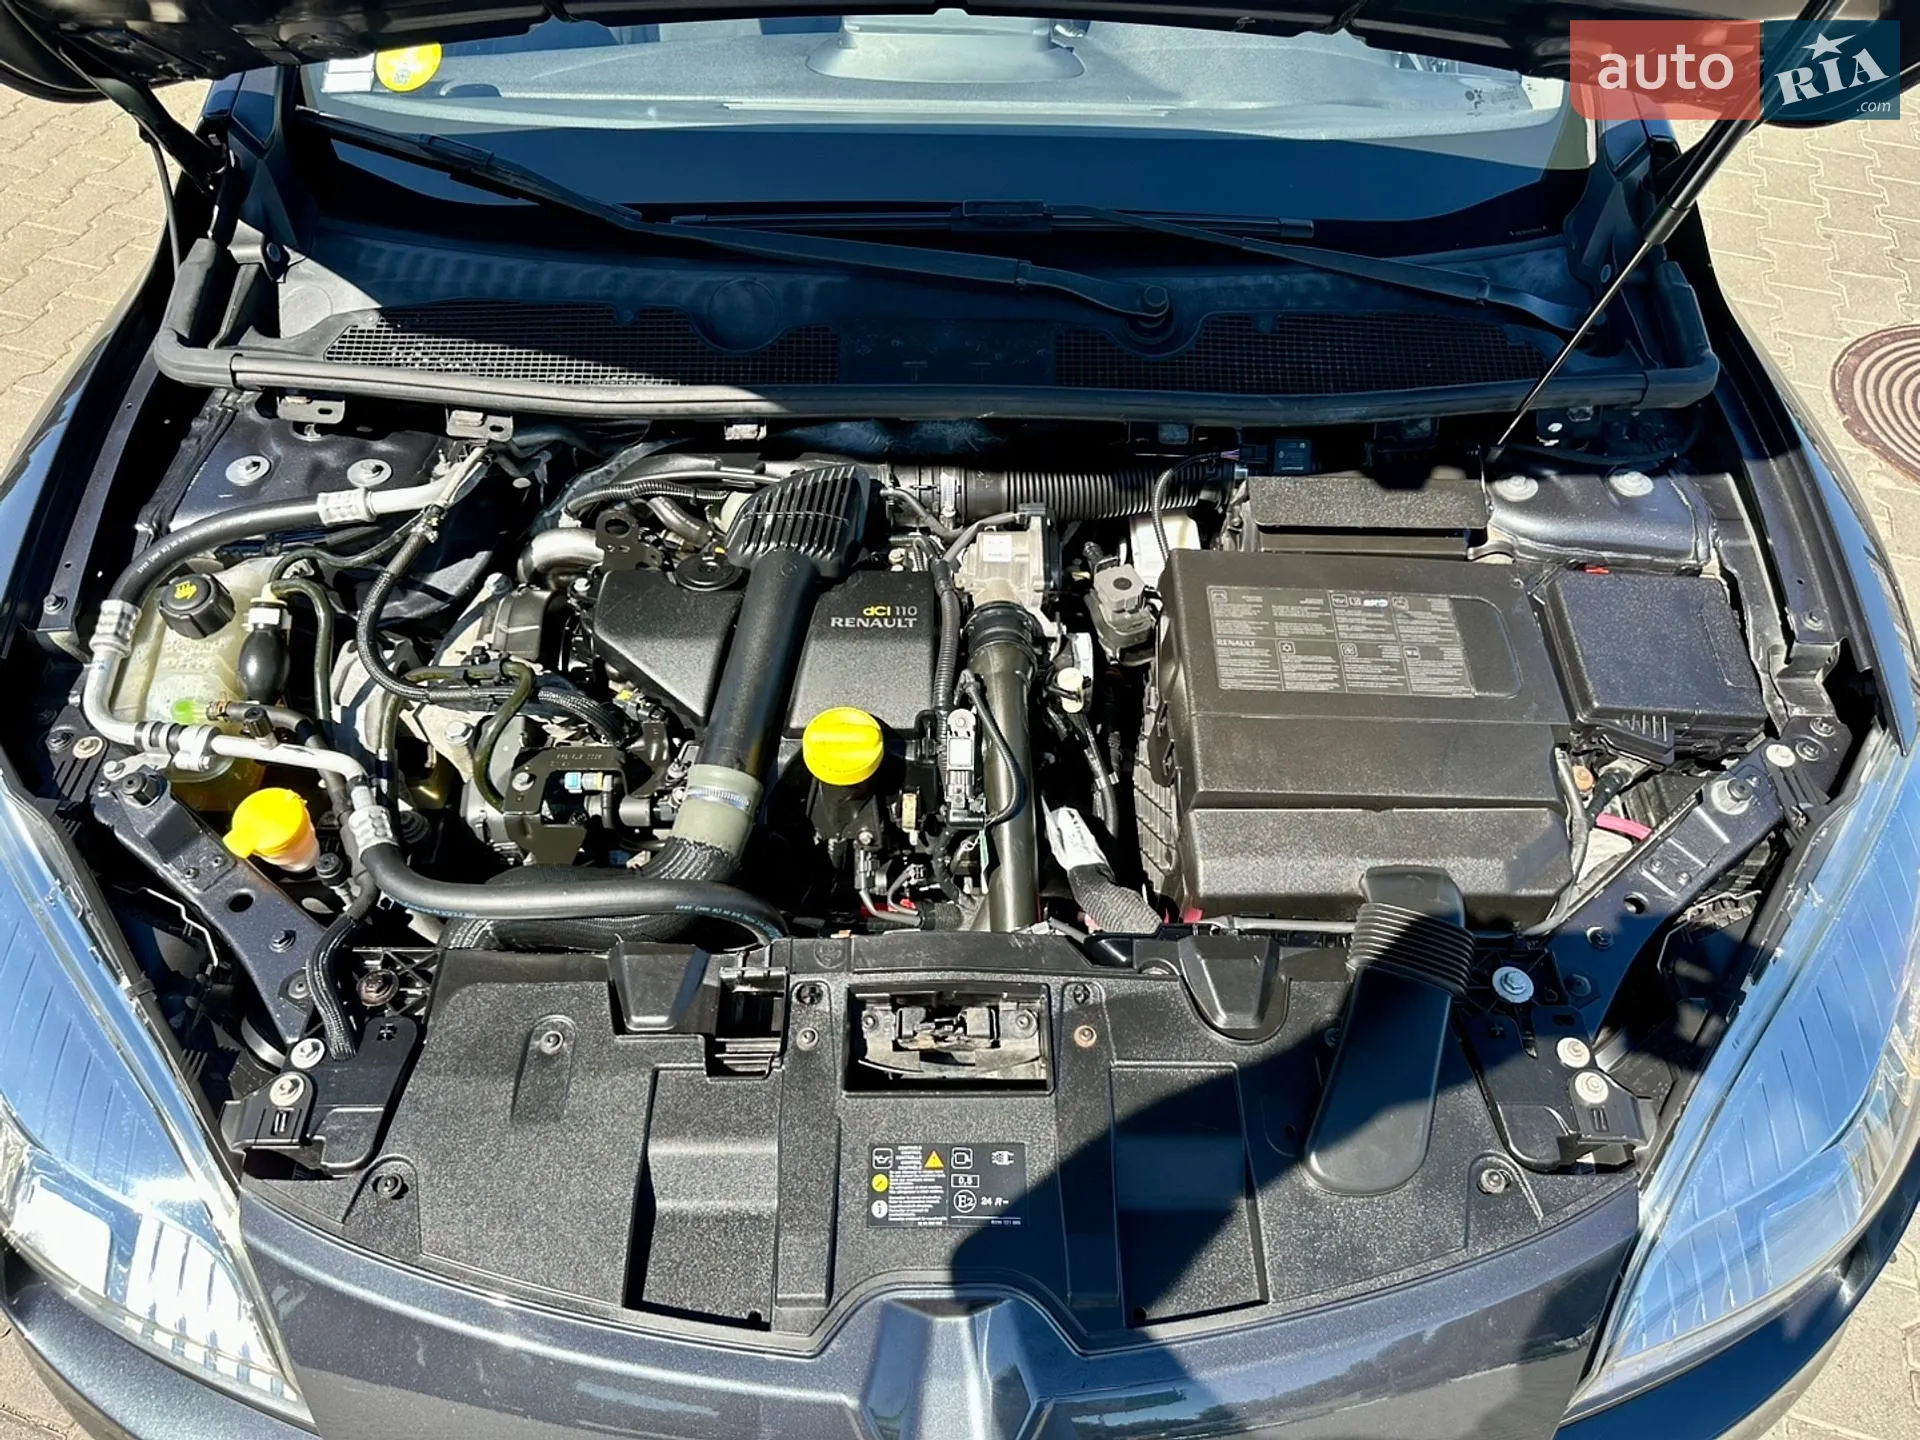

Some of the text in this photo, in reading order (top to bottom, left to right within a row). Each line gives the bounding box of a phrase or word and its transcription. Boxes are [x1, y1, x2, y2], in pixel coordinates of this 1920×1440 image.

[895, 605, 918, 616] 110
[830, 617, 918, 628] RENAULT
[1216, 639, 1256, 647] RENAULT
